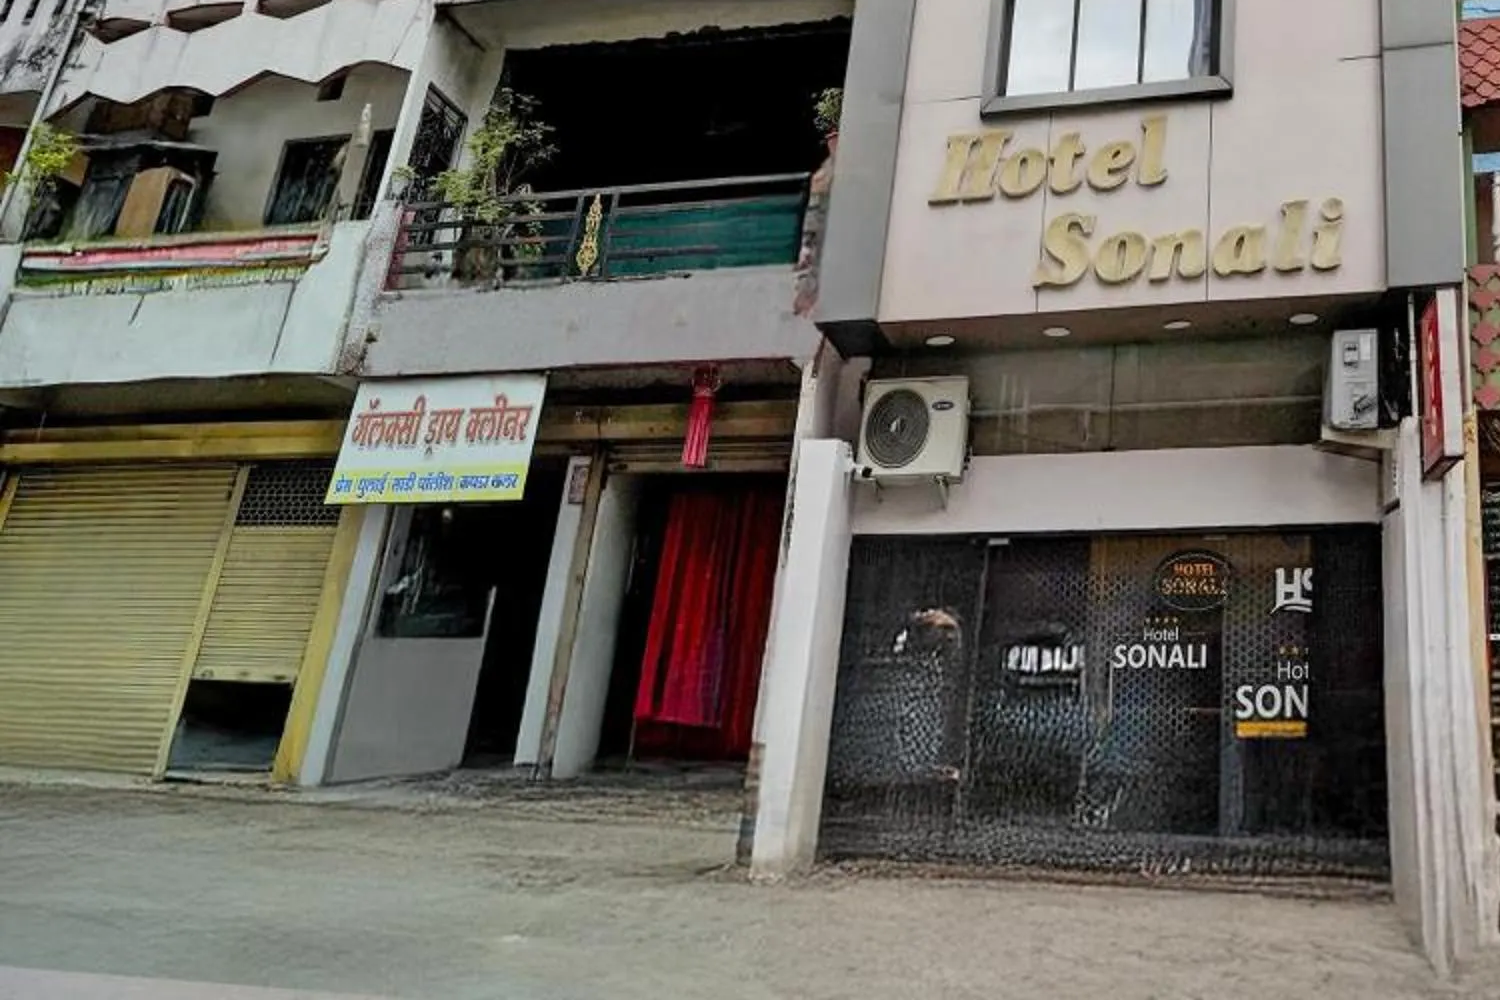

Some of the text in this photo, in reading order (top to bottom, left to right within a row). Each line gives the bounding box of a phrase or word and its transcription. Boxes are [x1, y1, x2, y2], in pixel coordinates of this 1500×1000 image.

[928, 114, 1169, 207] Hotel
[1031, 197, 1344, 290] Sonali
[466, 393, 533, 443] क्लीनर
[1143, 626, 1179, 641] Hotel
[1111, 643, 1208, 669] SONALI
[1235, 684, 1309, 719] SON
